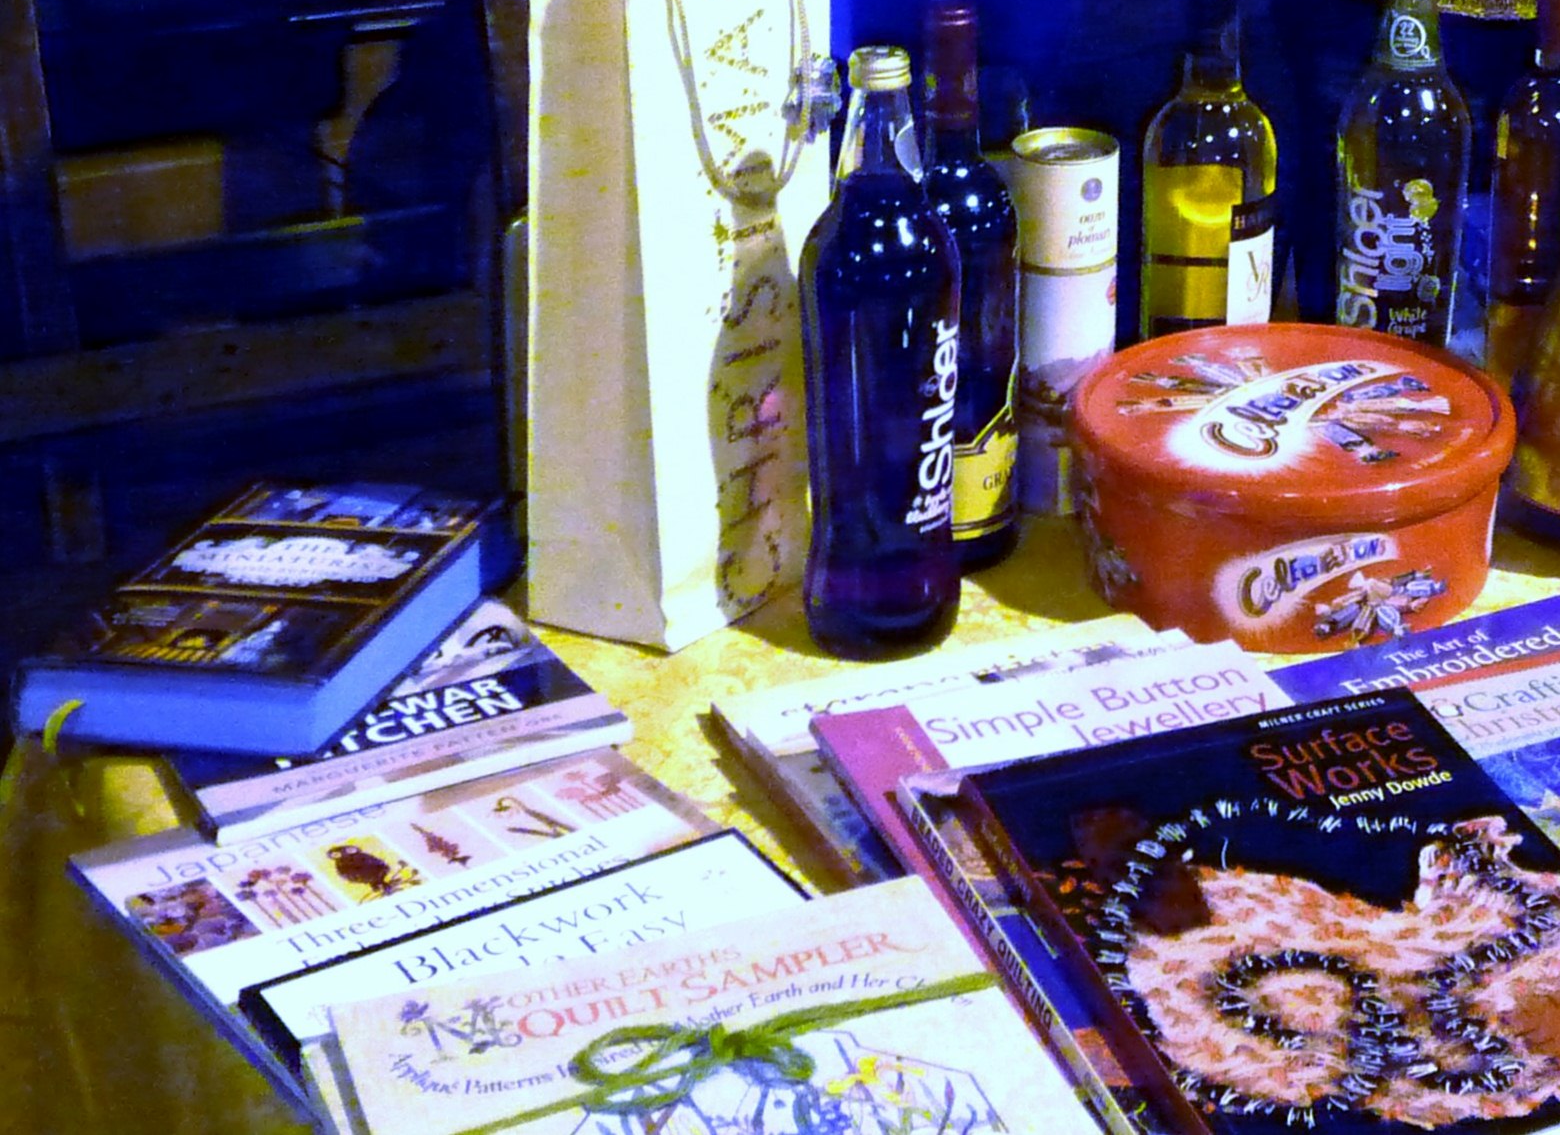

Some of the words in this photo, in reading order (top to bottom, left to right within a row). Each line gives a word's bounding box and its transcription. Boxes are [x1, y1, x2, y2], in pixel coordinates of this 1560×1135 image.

[918, 319, 959, 491] Shloer
[1384, 639, 1427, 667] The
[1431, 635, 1463, 656] Art
[1465, 628, 1490, 646] of
[322, 692, 523, 758] TCHEN
[364, 677, 502, 726] -WAR
[926, 687, 1083, 745] Simple
[1090, 666, 1249, 713] Button
[1073, 689, 1267, 747] Jewellery
[1306, 705, 1342, 720] CRAFT
[1344, 696, 1385, 713] SERIES
[1251, 722, 1414, 771] Surface
[1266, 747, 1438, 800] Works
[1327, 785, 1385, 810] Jenny
[1386, 769, 1453, 796] Dowde
[280, 835, 610, 955] Three-Dimensional
[394, 880, 663, 984] Blackwork
[517, 984, 671, 1040] QUILT
[682, 928, 926, 1004] SAMPLER
[748, 981, 803, 1009] Earth
[808, 973, 847, 996] and
[997, 938, 1053, 1025] QUILTING
